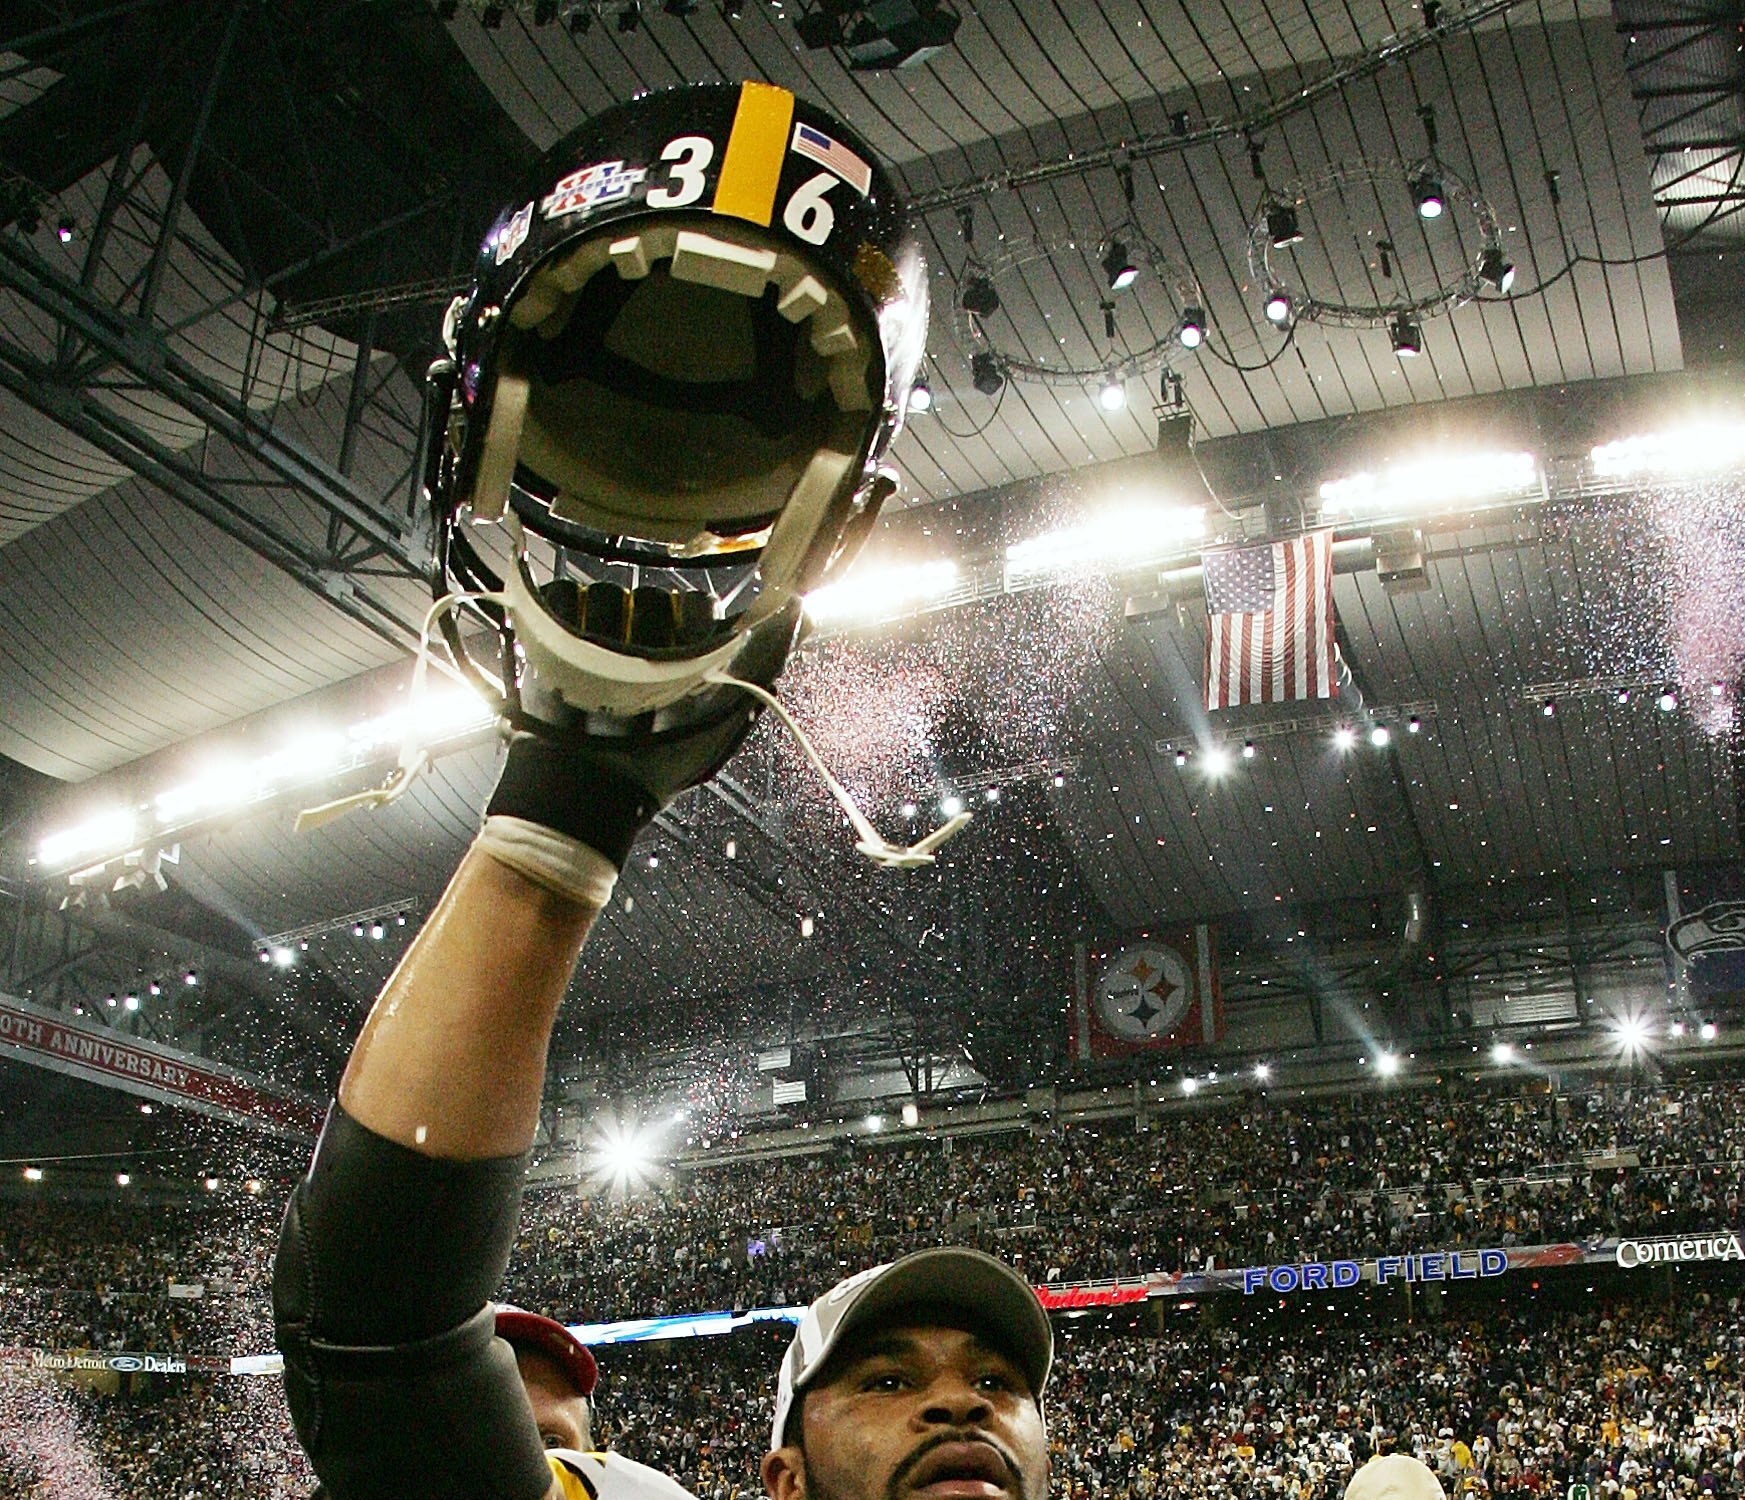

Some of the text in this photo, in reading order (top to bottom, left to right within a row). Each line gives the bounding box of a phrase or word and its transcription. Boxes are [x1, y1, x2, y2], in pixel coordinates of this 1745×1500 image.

[51, 1031, 189, 1087] ANNIVERSARY
[1244, 1249, 1508, 1294] FORD FIELD
[145, 1356, 187, 1373] Dealers
